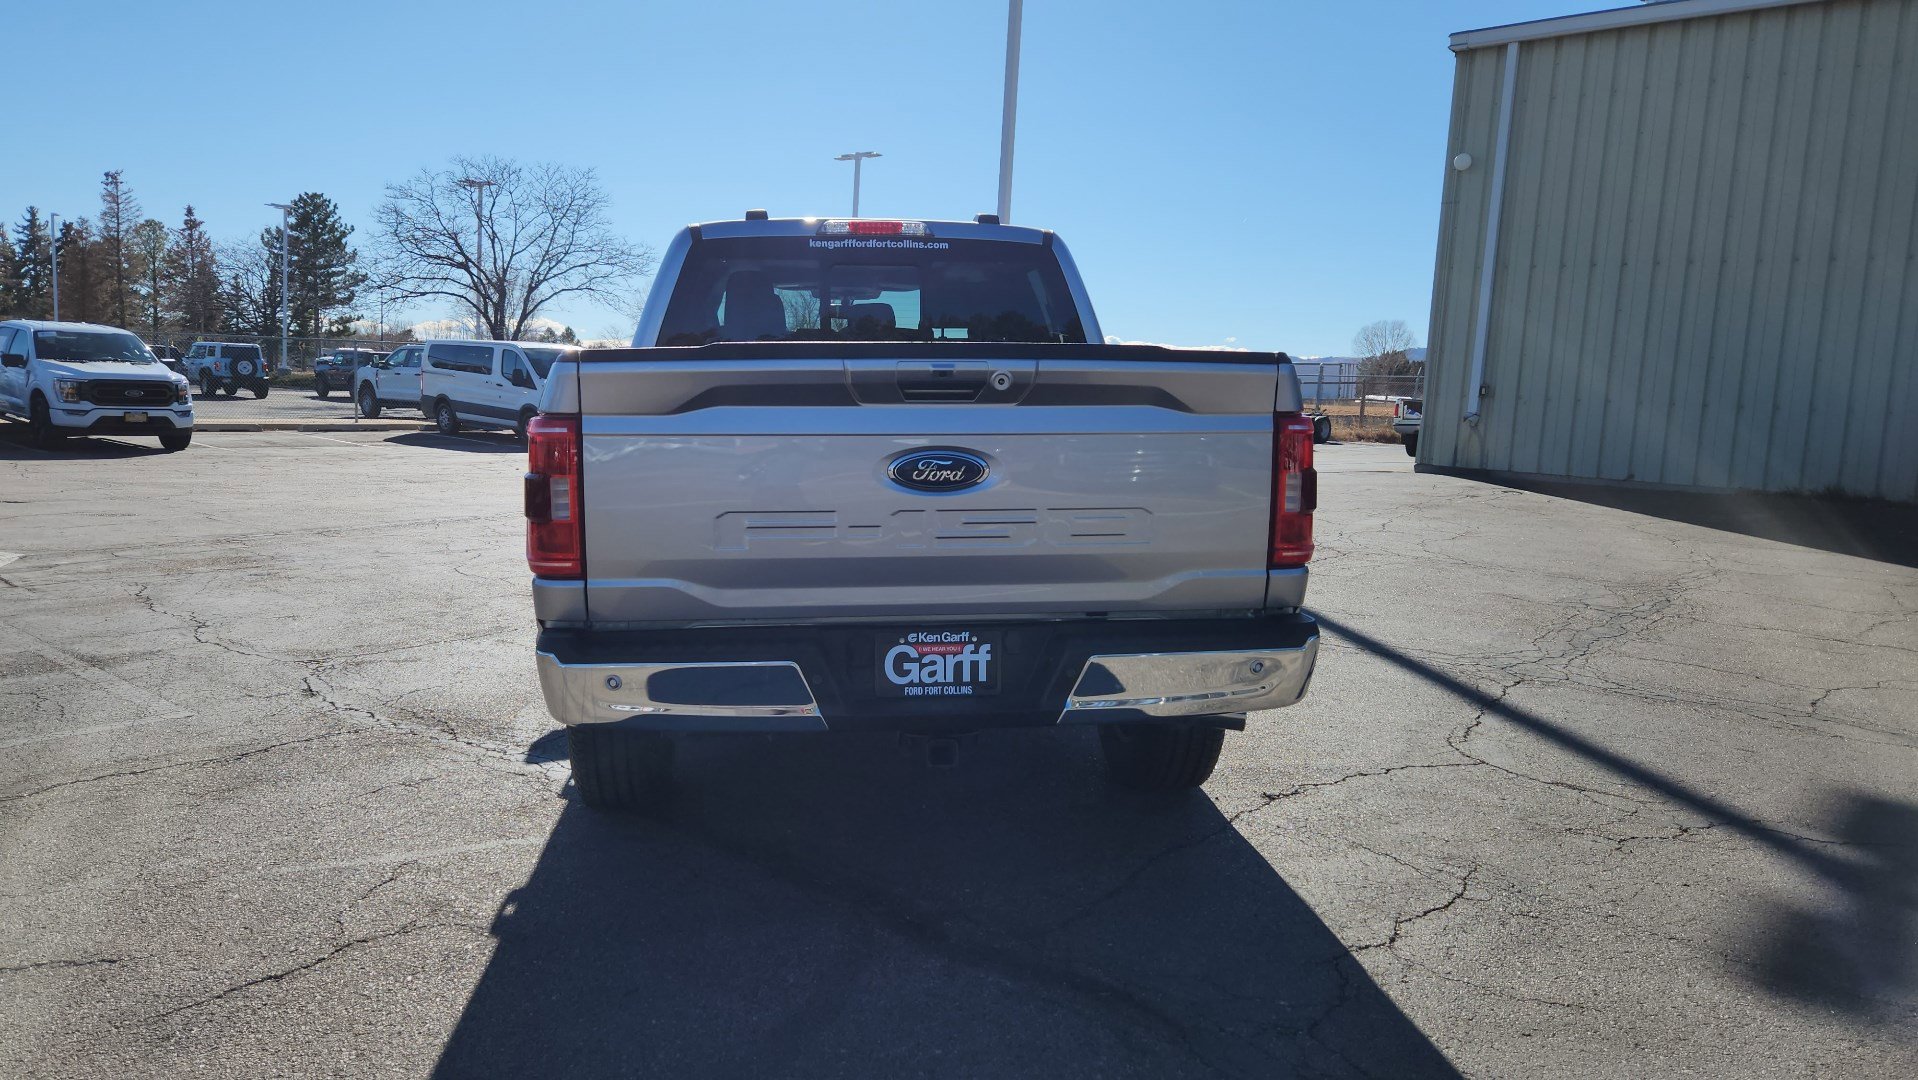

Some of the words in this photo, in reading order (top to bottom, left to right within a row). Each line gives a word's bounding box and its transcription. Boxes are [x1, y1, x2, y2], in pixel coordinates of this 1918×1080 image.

[809, 239, 949, 249] kengarfffordfortcollins.com
[912, 460, 966, 481] Ford
[918, 632, 941, 643] Ken
[942, 632, 970, 642] Garff
[884, 644, 991, 684] Garff
[904, 687, 923, 696] FORD
[925, 687, 942, 695] FORT
[944, 686, 973, 695] COLLINS
